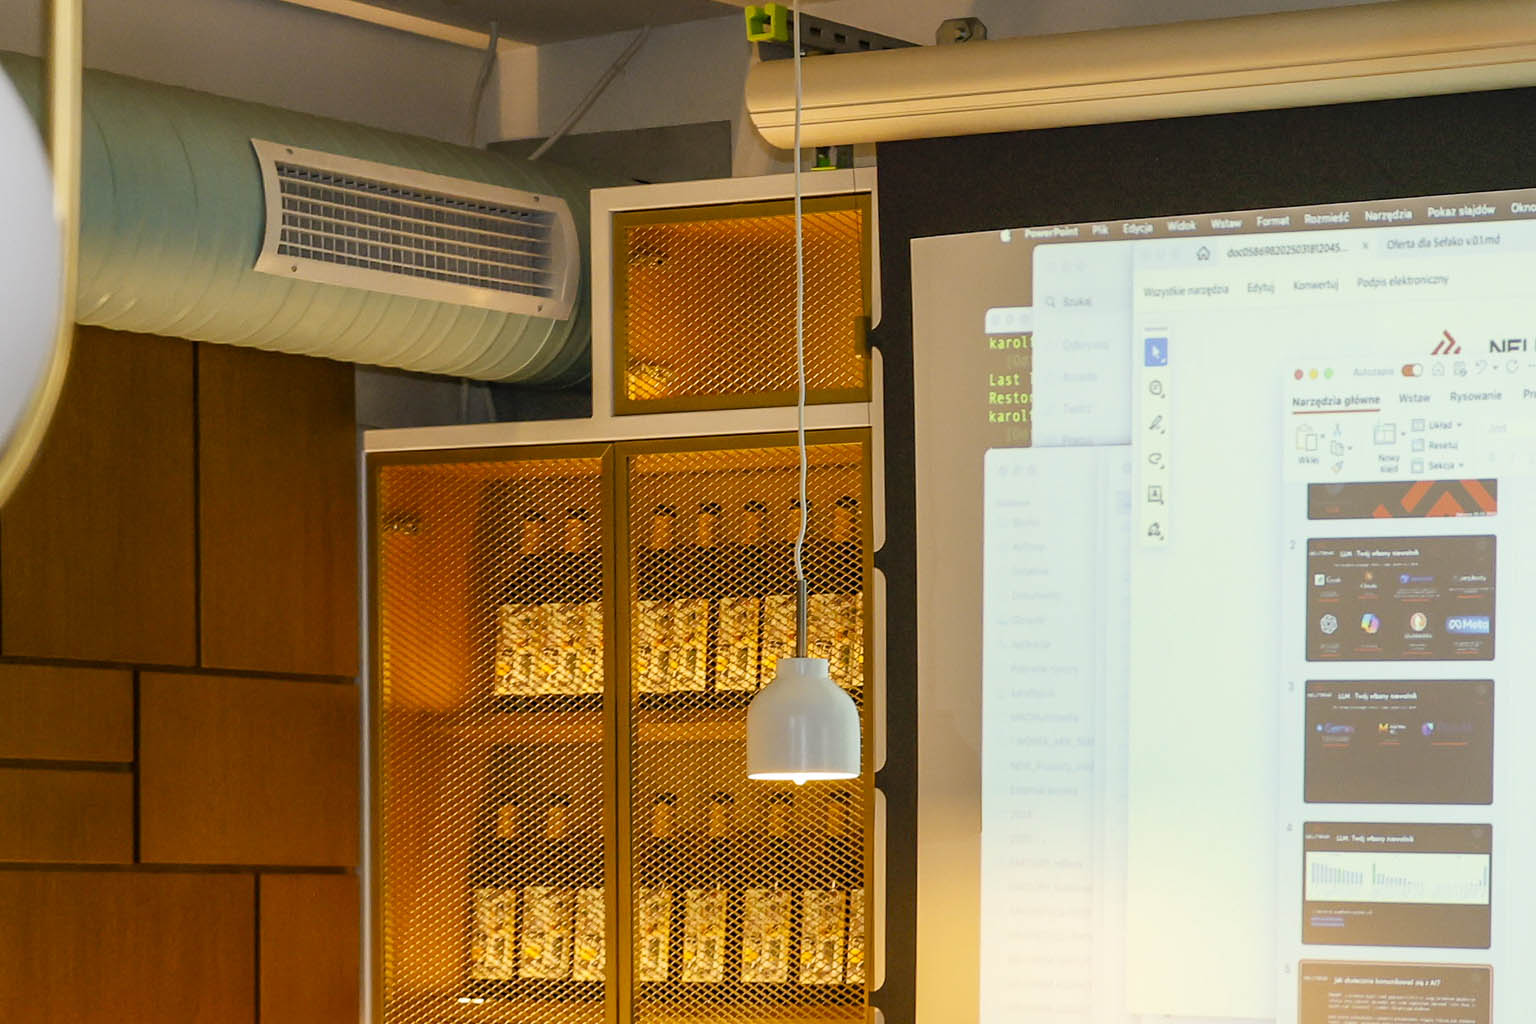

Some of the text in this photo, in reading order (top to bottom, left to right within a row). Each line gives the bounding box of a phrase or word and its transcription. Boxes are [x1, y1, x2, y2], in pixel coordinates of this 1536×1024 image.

[1426, 203, 1496, 217] Pokaz slajdów
[1510, 201, 1536, 214] Okno
[1255, 215, 1290, 226] Format
[1303, 210, 1350, 224] Rozmieść
[1363, 208, 1412, 222] Narzędzia
[1121, 221, 1153, 234] Edycja
[1165, 219, 1196, 231] Widok
[1209, 217, 1242, 229] Wstaw
[988, 374, 1021, 387] Last
[1291, 394, 1381, 408] Narzędzia główne
[1398, 393, 1431, 403] Wstaw
[1449, 391, 1502, 403] Rysowanie
